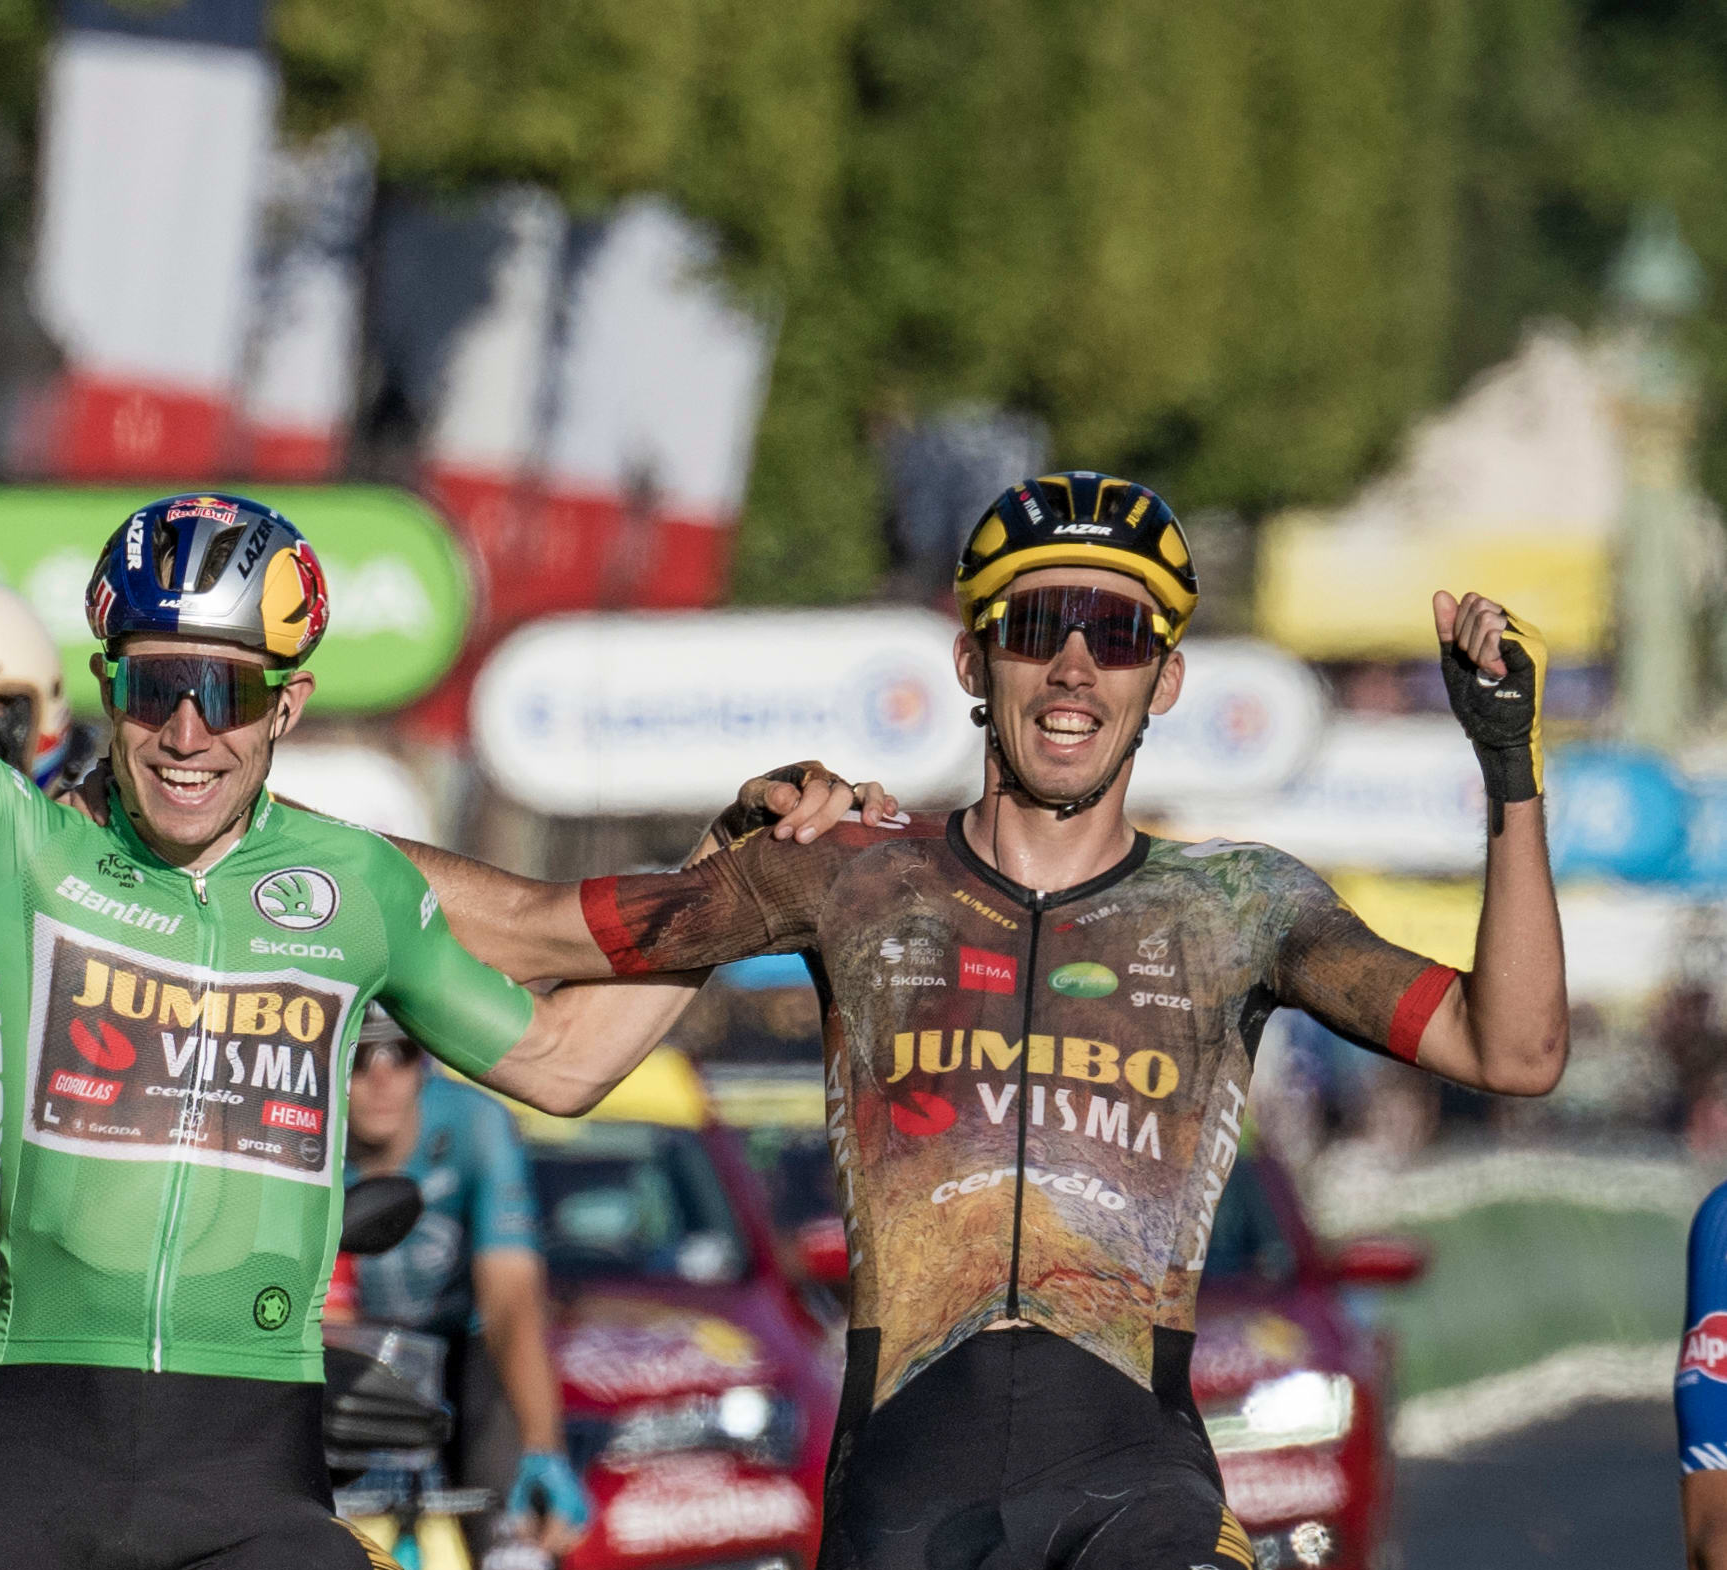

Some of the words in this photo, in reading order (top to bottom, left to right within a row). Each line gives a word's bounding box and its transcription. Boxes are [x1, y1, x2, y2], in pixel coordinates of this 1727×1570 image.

[126, 511, 147, 571] LAZER
[1053, 523, 1113, 536] LAZER
[236, 518, 275, 580] LAZER
[55, 874, 184, 935] Santini
[951, 888, 1019, 930] JUMBO
[1075, 903, 1121, 926] VISMA
[249, 936, 346, 961] ŠKODA
[909, 937, 929, 947] UCI
[889, 973, 947, 987] ŠKODA
[964, 962, 1013, 981] HEMA
[1128, 963, 1176, 978] AGU
[71, 958, 326, 1043] JUMBO
[1130, 991, 1193, 1011] graze
[160, 1031, 319, 1098] VISMA
[885, 1029, 1180, 1100] JUMBO
[54, 1072, 114, 1101] GORILLAS
[145, 1085, 245, 1106] cervélo
[270, 1106, 317, 1130] HEMA
[975, 1082, 1162, 1160] VISMA
[237, 1137, 283, 1154] graze
[930, 1166, 1128, 1211] cervélo
[1186, 1080, 1248, 1272] HEMA
